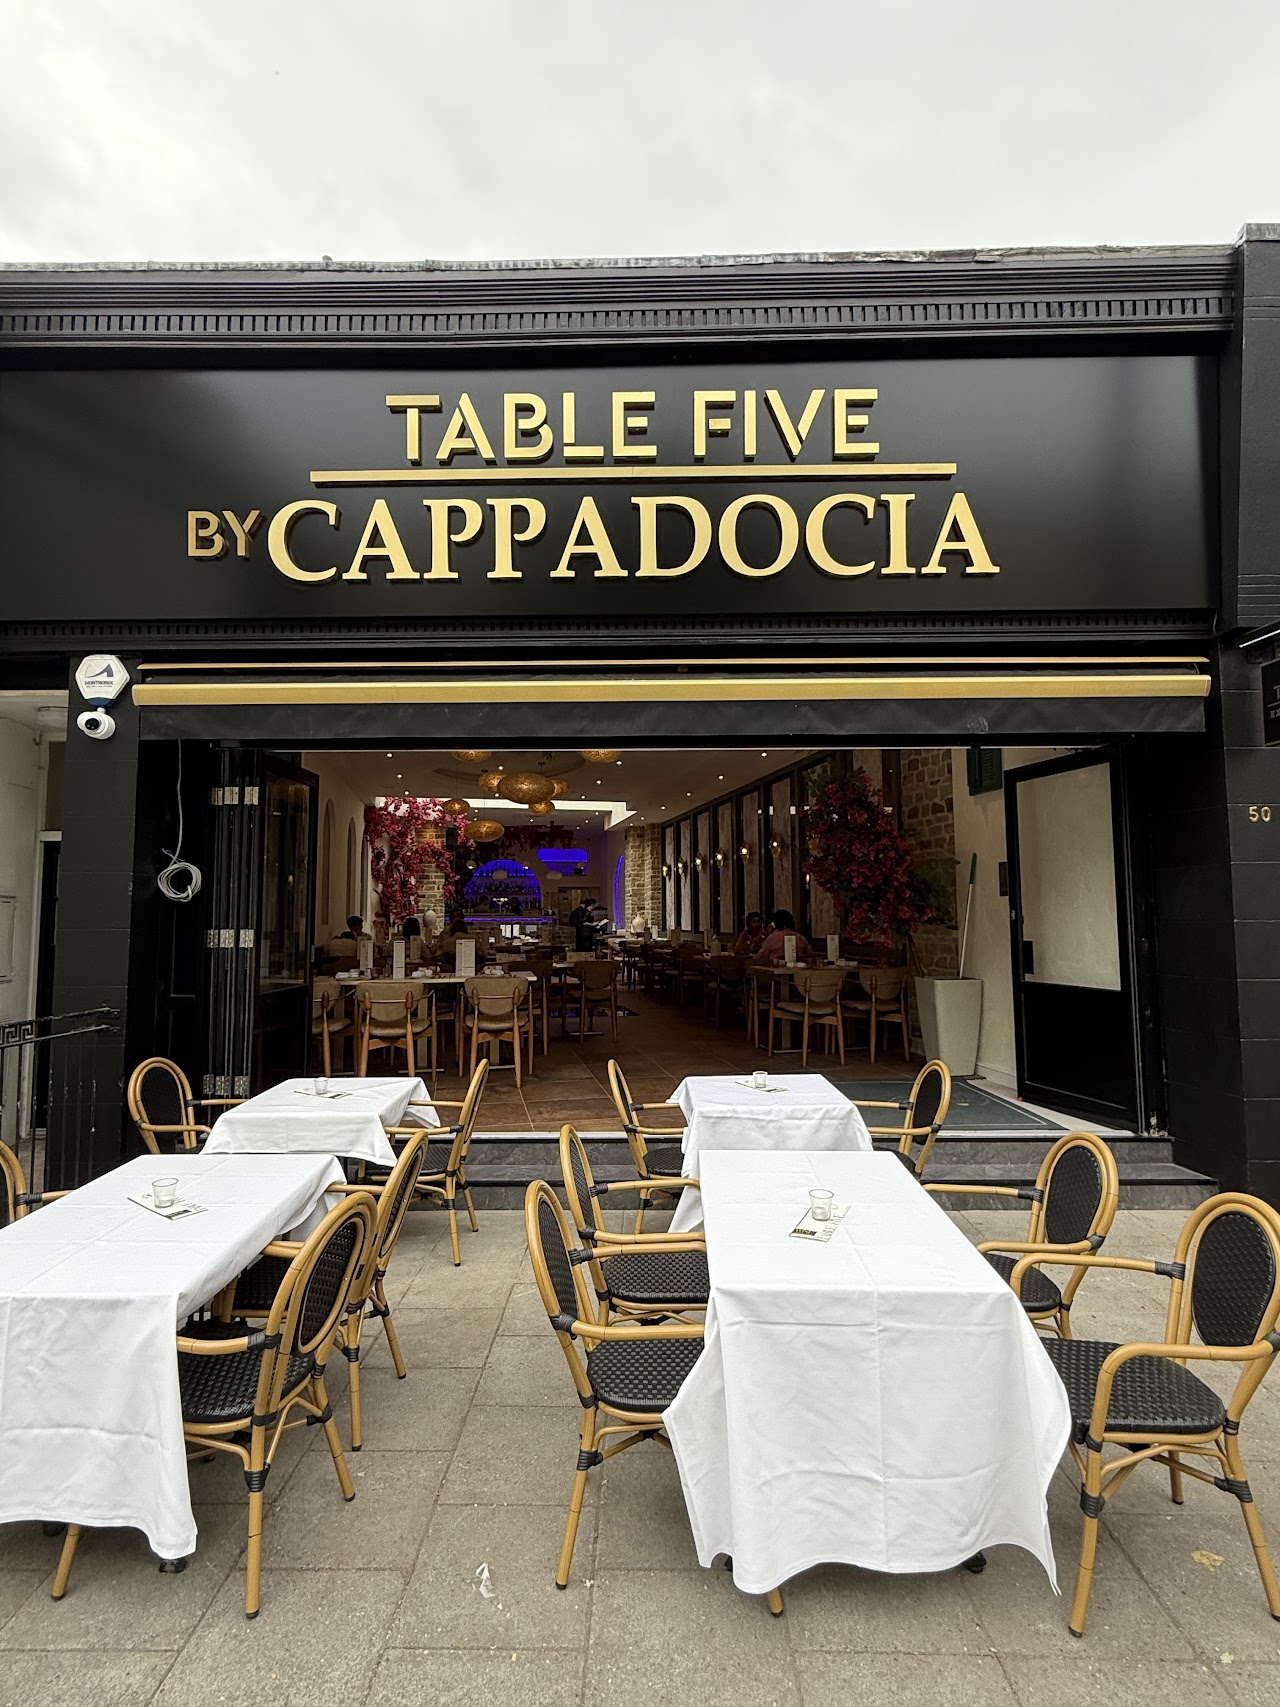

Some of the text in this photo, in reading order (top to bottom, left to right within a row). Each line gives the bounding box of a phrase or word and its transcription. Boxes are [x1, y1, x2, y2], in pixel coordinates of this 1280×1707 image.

[386, 388, 880, 462] TABLE FIVE
[187, 491, 1001, 582] BY CAPPADOCIA
[1249, 806, 1271, 822] 50
